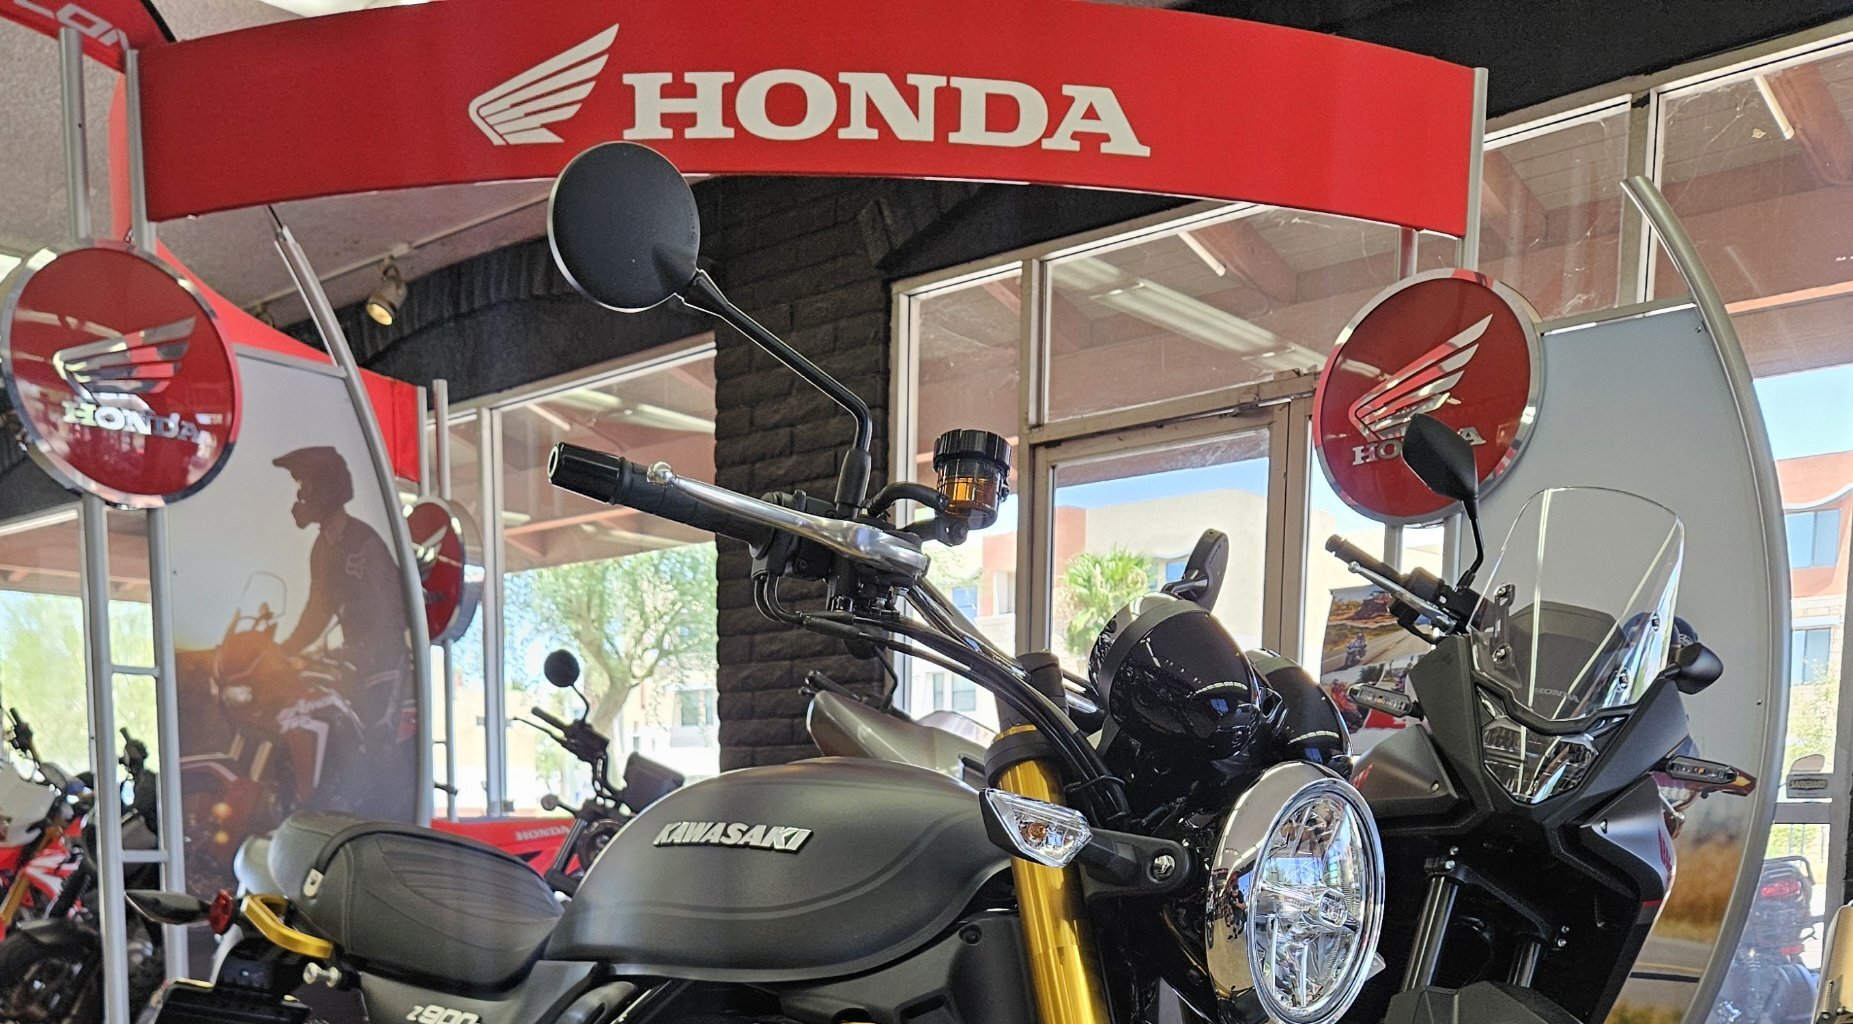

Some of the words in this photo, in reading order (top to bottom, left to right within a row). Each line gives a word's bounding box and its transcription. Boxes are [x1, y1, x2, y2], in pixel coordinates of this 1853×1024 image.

[623, 69, 1151, 157] HONDA
[62, 400, 202, 444] HONDA
[1352, 426, 1487, 466] HOA
[653, 821, 812, 851] KAWASAKI
